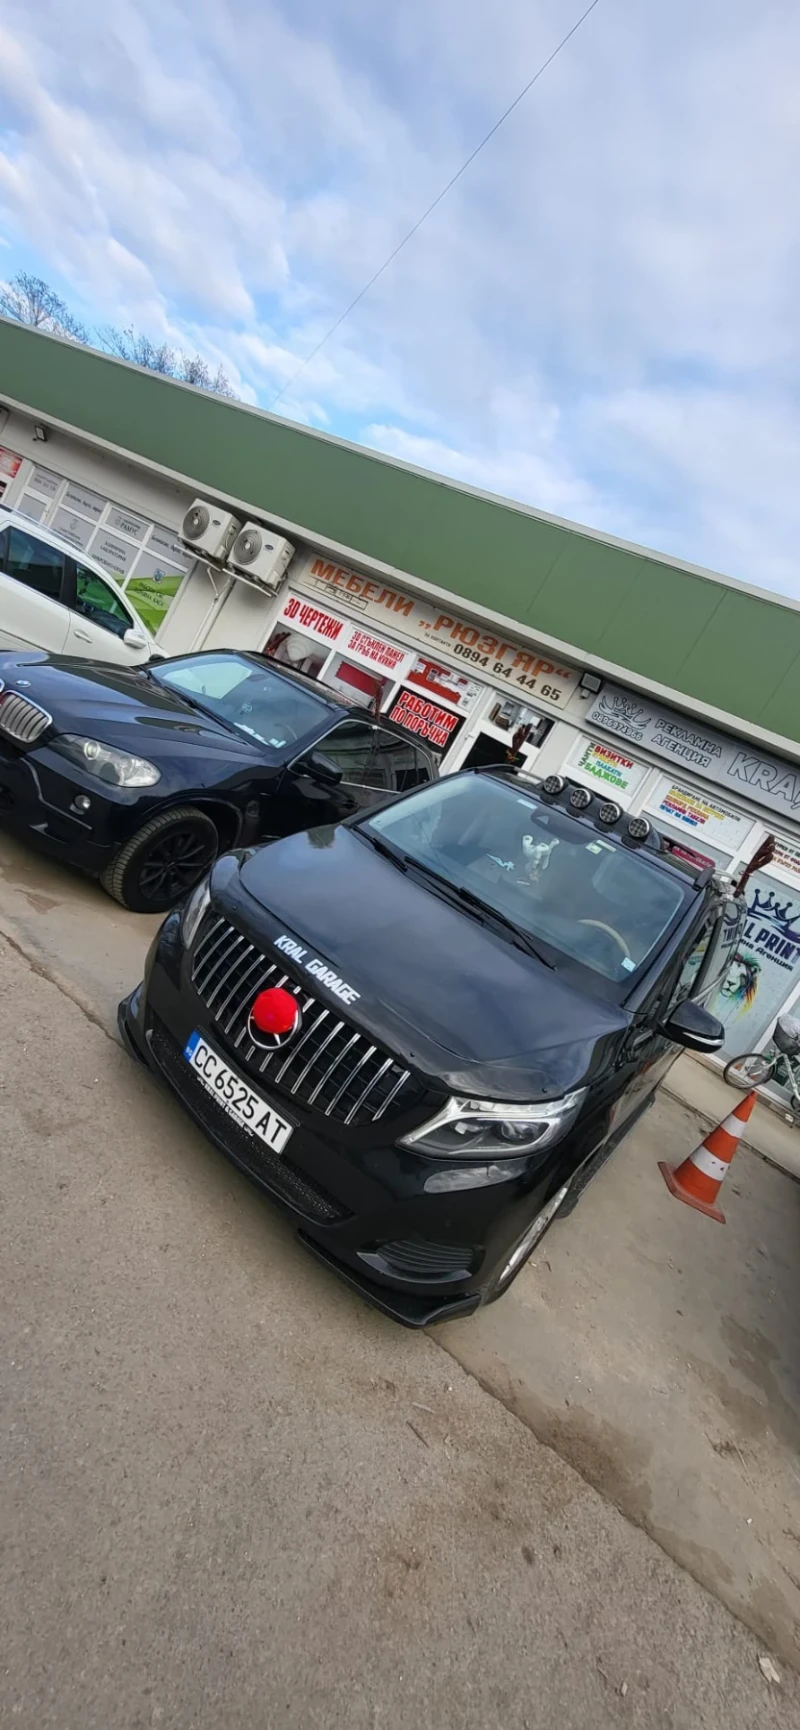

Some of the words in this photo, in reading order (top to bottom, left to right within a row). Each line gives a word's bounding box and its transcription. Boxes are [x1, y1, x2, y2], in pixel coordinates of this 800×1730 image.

[310, 560, 415, 617] МЕБЕЛИ
[283, 598, 301, 619] 3D
[296, 605, 343, 640] ЧЕРТЕЖИ
[348, 640, 357, 649] ЗА
[356, 644, 371, 656] ГРЪБ
[369, 651, 379, 660] НА
[359, 635, 386, 654] СТЪКЛЕН
[384, 647, 405, 663] ПАНЕЛ
[453, 644, 490, 667] 0894
[492, 662, 513, 678] 64
[516, 673, 537, 689] 44
[540, 685, 562, 701] 65
[390, 706, 409, 724] ПО
[404, 714, 450, 747] ПОРЪЧКА
[398, 691, 459, 732] РАБОТИМ
[591, 711, 643, 741] 0896974966
[578, 743, 596, 767] ЧАНТИ
[652, 734, 711, 768] АГЕНЦИЯ
[655, 719, 723, 757] РЕКЛАМНА
[595, 746, 633, 769] ВИЗИТКИ
[585, 763, 628, 789] БАДЖОВЕ
[727, 751, 797, 802] KRA
[709, 804, 741, 822] АВТОМОБИЛИ
[755, 928, 799, 964] PRINT
[756, 947, 793, 971] Агенция
[274, 934, 307, 964] KRAL
[305, 959, 361, 1005] GARAGE
[194, 1046, 217, 1078] CC
[214, 1069, 259, 1119] 6525
[255, 1112, 287, 1143] AT
